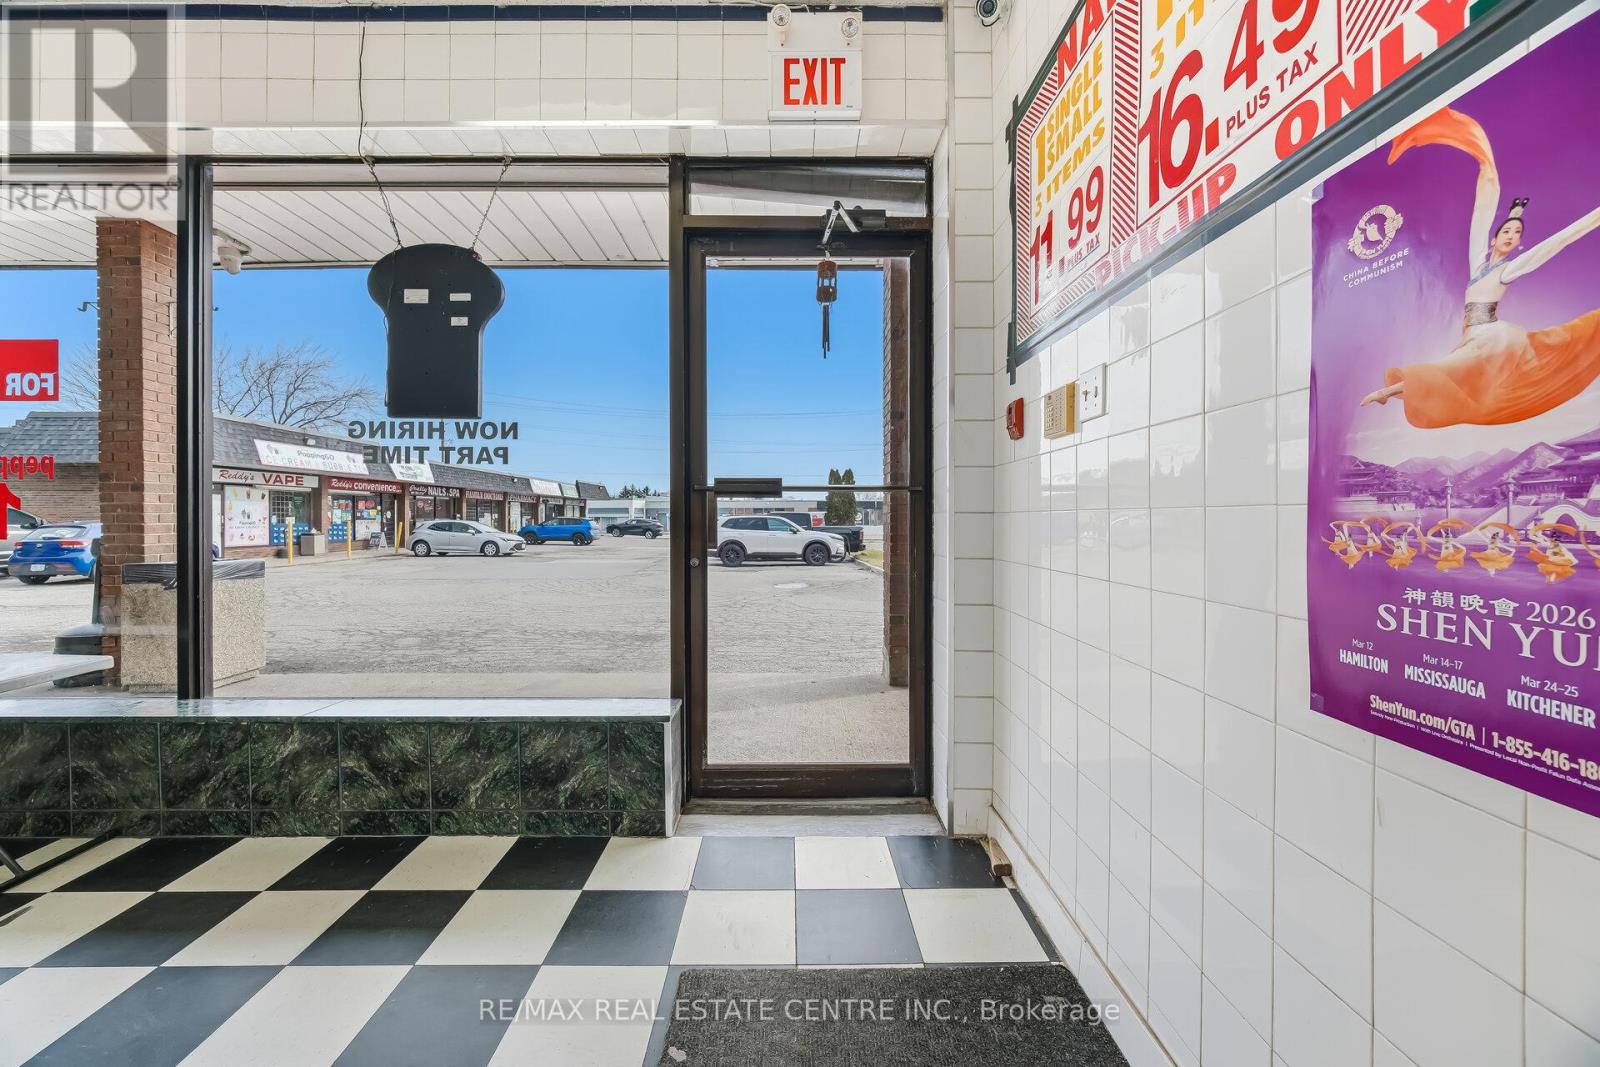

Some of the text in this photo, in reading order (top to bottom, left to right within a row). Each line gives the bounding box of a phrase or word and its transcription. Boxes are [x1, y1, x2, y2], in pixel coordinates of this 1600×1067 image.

[783, 57, 846, 106] EXIT
[1047, 41, 1103, 144] SINGLE
[1226, 86, 1271, 138] PLUS
[1276, 41, 1320, 93] TAX
[1274, 0, 1468, 161] ONLY
[1047, 82, 1103, 173] SMALL
[1046, 116, 1105, 203] ITEMS
[1086, 232, 1101, 253] TAX
[1343, 248, 1410, 282] CHINA BEFORE
[1348, 260, 1404, 288] COMMUNISM
[218, 469, 305, 486] Reddy's VAPE
[331, 478, 353, 489] Reddy's
[353, 482, 397, 492] convenience
[427, 486, 447, 496] NAILS
[449, 489, 460, 498] SPA
[1403, 587, 1520, 618] 神韻晚會
[1526, 601, 1596, 630] 2026
[1352, 638, 1374, 650] Mar 12
[1376, 603, 1495, 651] SHEN
[1339, 648, 1389, 674] HAMILTON
[1423, 653, 1438, 665] Mar
[1404, 663, 1486, 699] MISSISSAUGA
[1520, 675, 1540, 689] Mar
[1369, 694, 1476, 741] ShenYun.com/GTA
[1506, 688, 1596, 729] KITCHENER
[1491, 731, 1600, 780] 1-855-416-18
